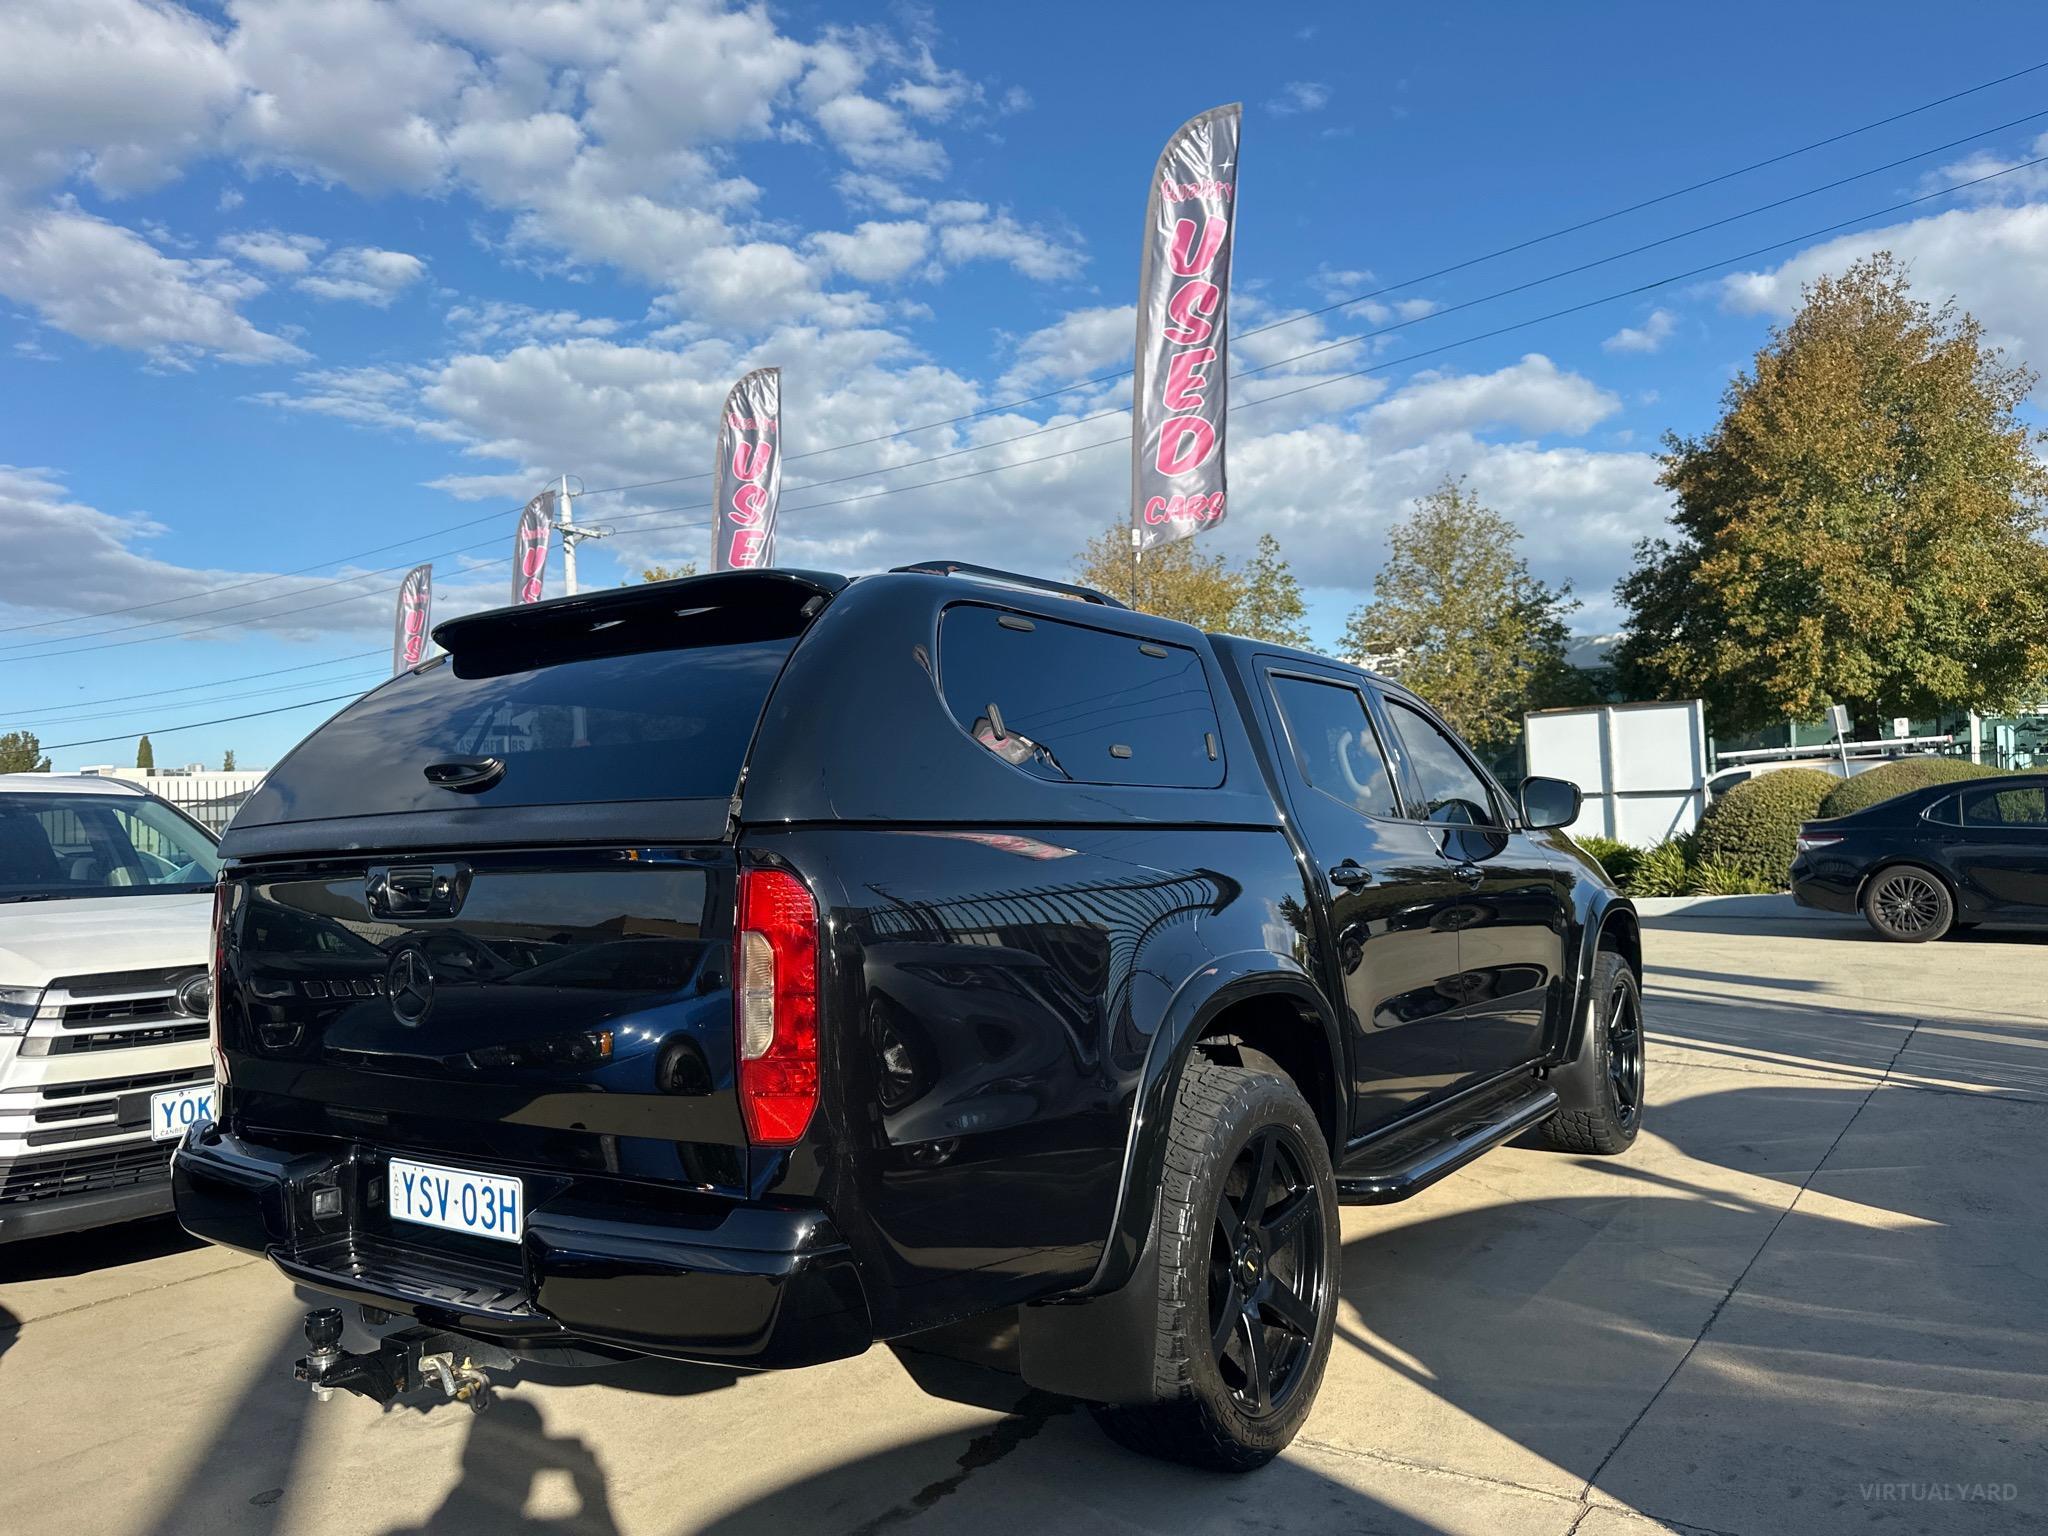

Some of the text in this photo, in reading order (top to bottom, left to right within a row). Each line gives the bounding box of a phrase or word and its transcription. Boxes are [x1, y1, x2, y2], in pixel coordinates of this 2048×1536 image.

[1155, 215, 1227, 477] USED
[1144, 492, 1225, 525] CARS
[161, 1095, 212, 1128] YOK
